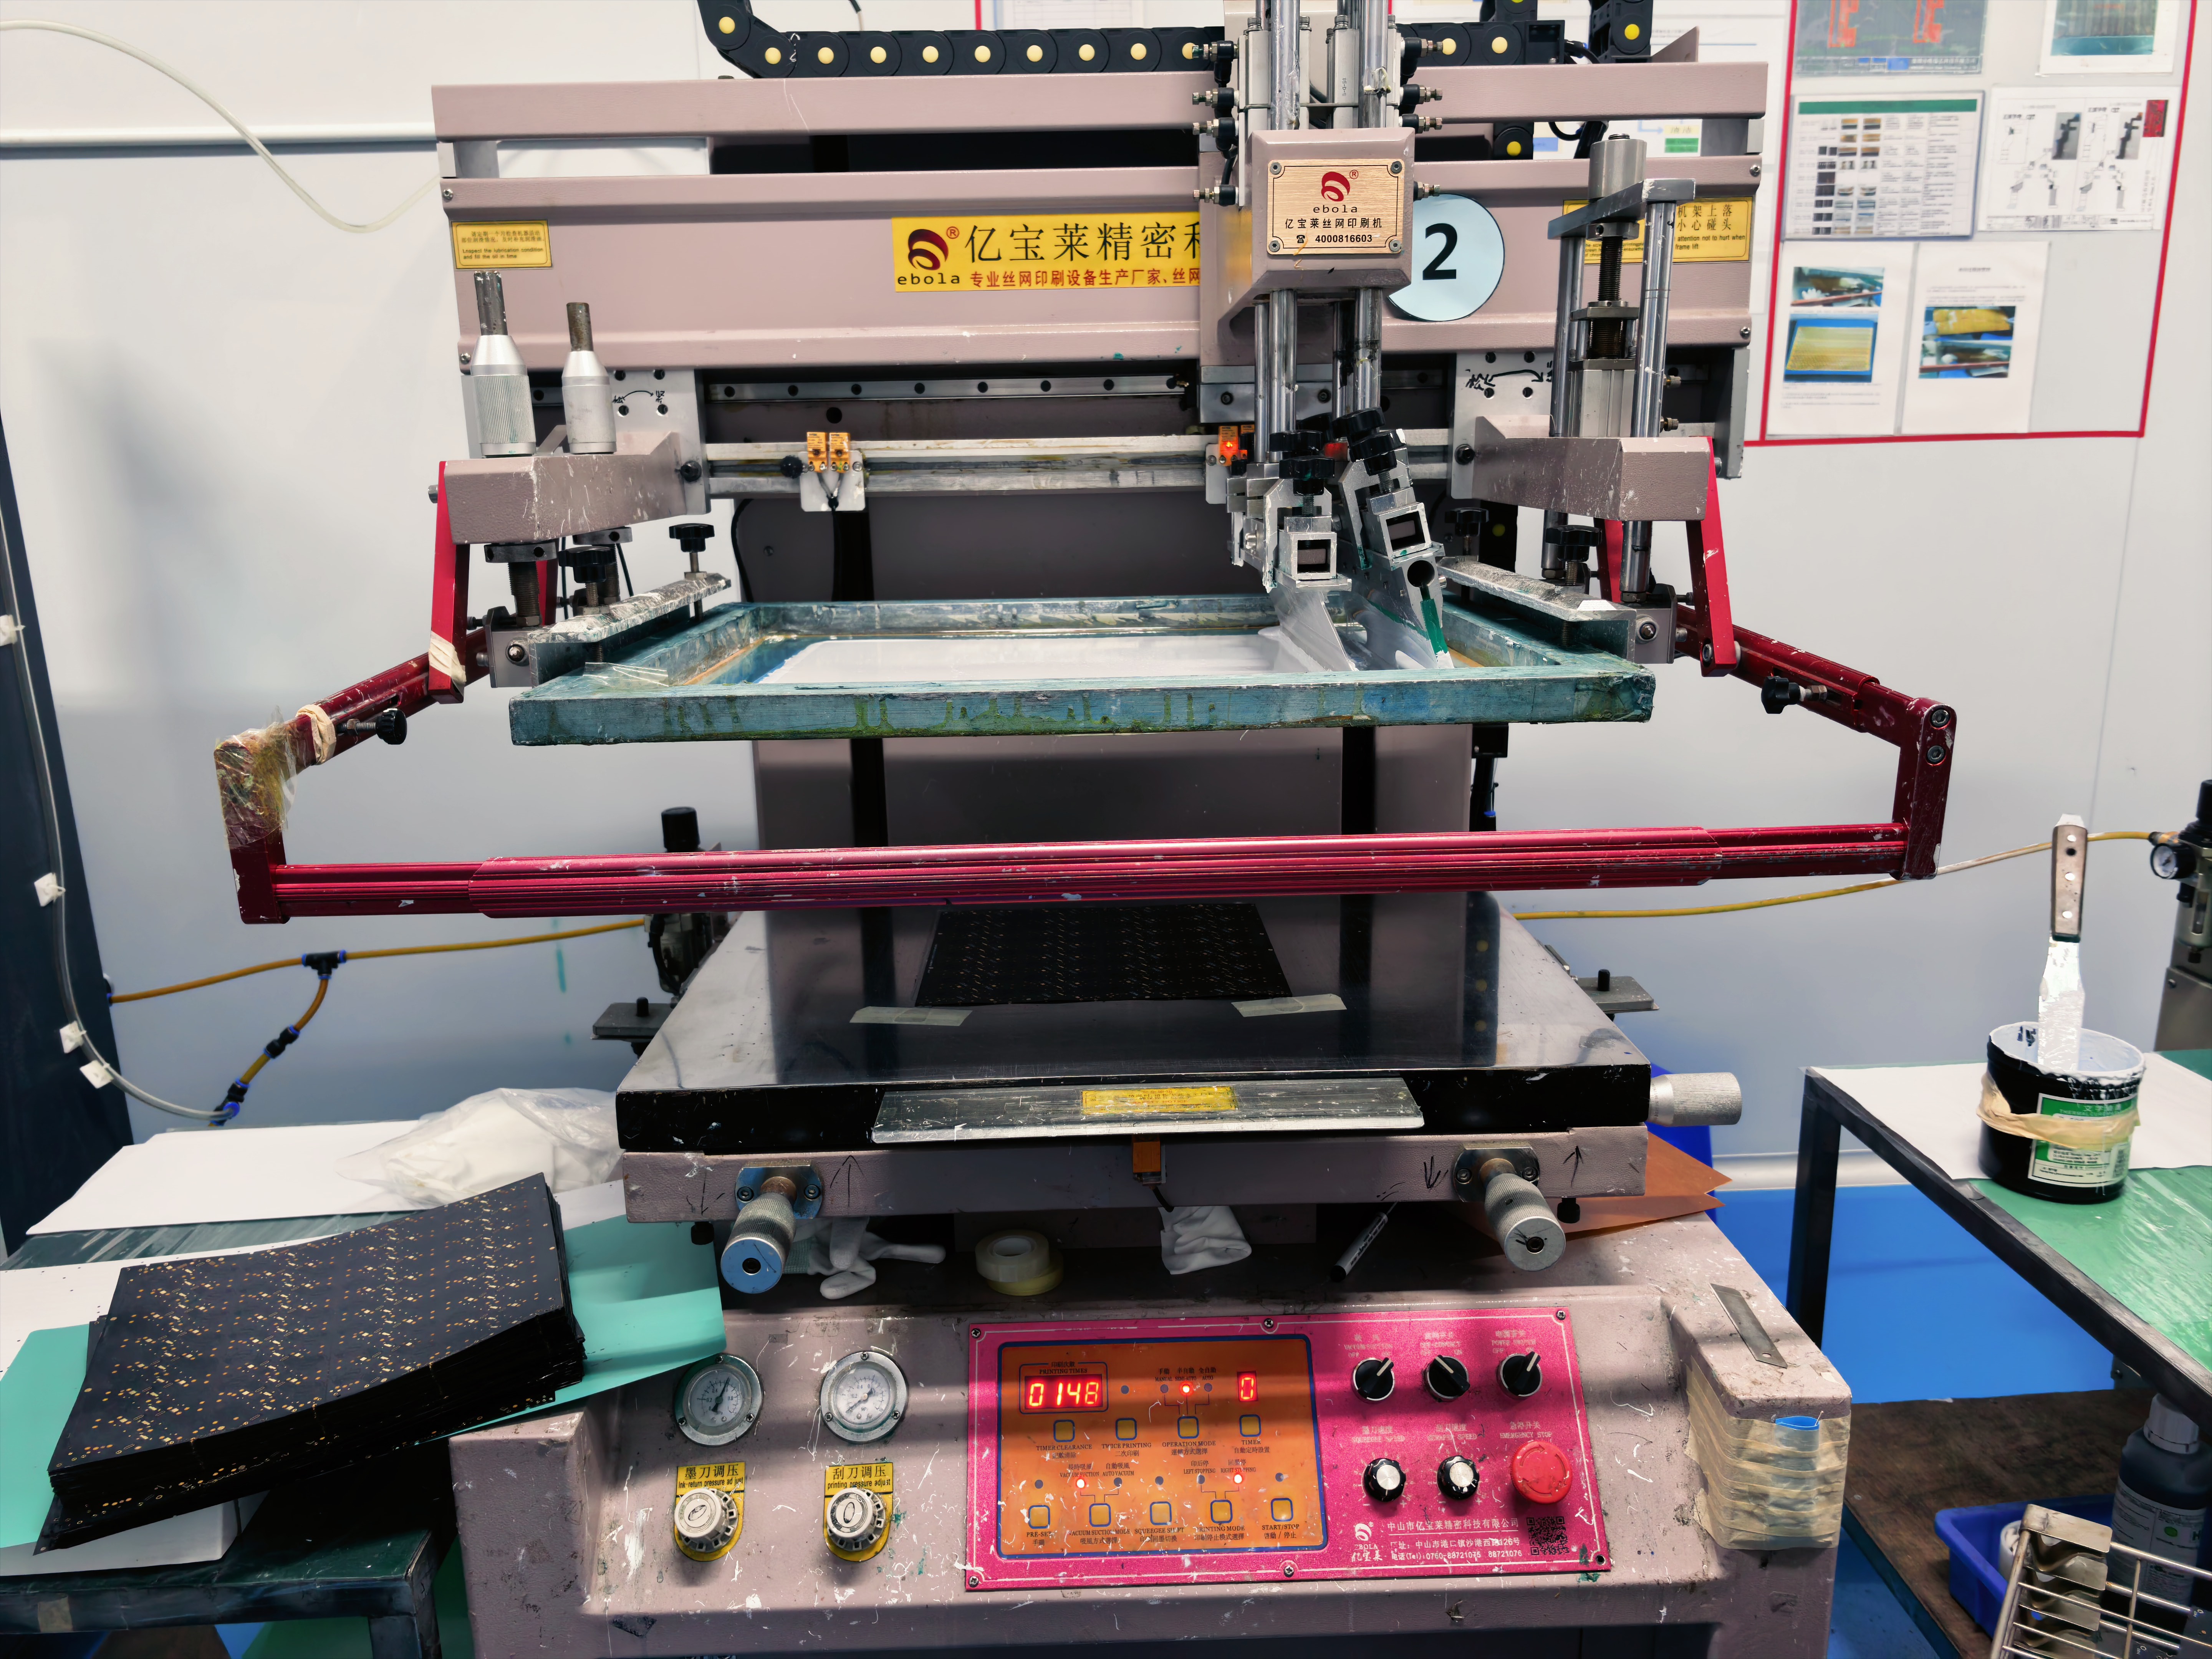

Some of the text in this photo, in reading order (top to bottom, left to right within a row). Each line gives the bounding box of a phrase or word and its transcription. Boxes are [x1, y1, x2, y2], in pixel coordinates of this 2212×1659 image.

[1313, 205, 1358, 213] ebola
[1285, 218, 1382, 229] 亿宝莱丝网印刷机
[1677, 218, 1731, 231] 小心碰头
[1315, 235, 1373, 243] 4000816603
[1423, 223, 1457, 280] 2
[897, 272, 960, 286] ebola
[1029, 1382, 1099, 1407] 0148
[1241, 1377, 1254, 1400] 0
[685, 1464, 738, 1480] 墨刀调压
[833, 1465, 886, 1480] 刮刀调压
[679, 1480, 702, 1488] Ink-return
[828, 1481, 847, 1490] printing
[874, 1478, 890, 1487] adjust
[1387, 1518, 1518, 1531] 中山市亿宝莱精密科技有限公司
